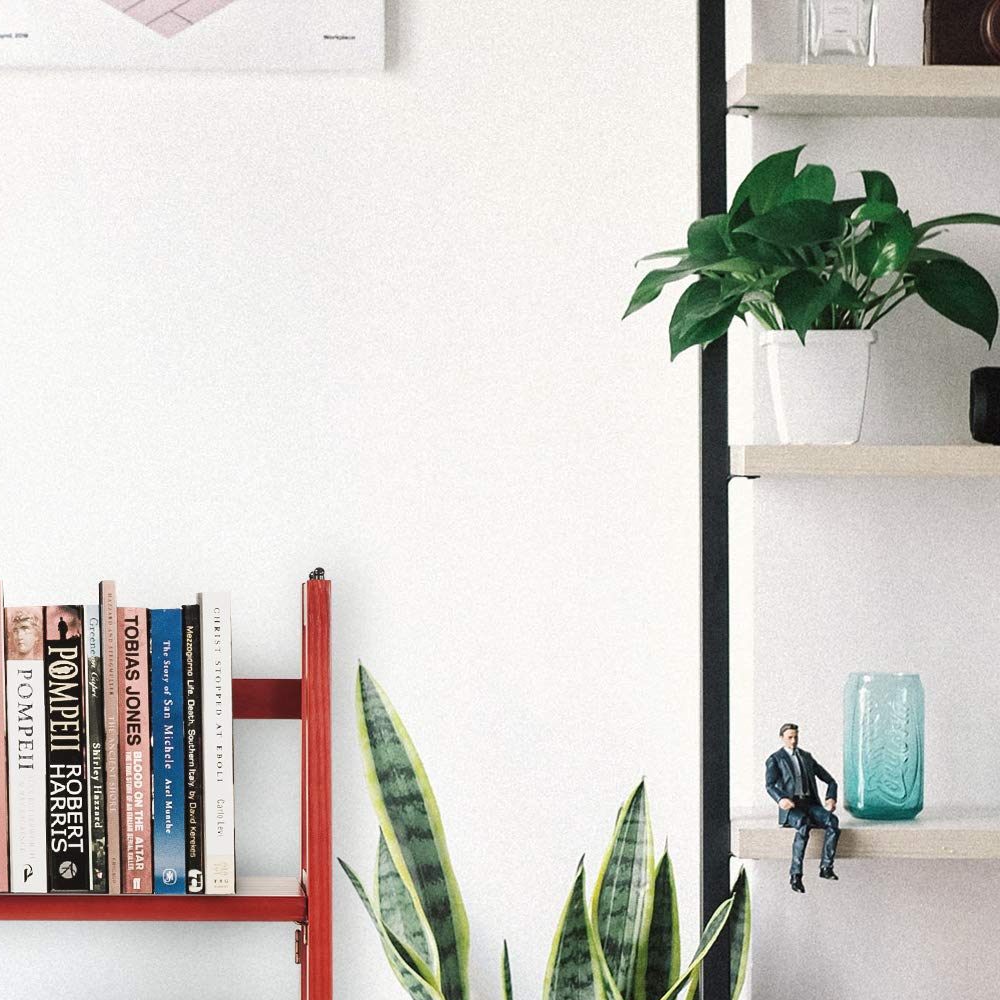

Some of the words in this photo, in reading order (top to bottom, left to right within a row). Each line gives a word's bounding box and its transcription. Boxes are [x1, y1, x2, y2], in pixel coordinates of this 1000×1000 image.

[88, 617, 98, 655] Greene
[124, 615, 140, 681] TOBIAS
[213, 607, 221, 652] CHRIST
[163, 640, 171, 657] The
[185, 625, 194, 677] Mezzogiorno
[162, 660, 172, 683] Story
[214, 661, 222, 716] STOPPED
[48, 645, 80, 751] POMPEII
[163, 686, 171, 695] of
[163, 699, 173, 719] San
[17, 669, 34, 769] POMPEII
[126, 686, 142, 746] JONES
[216, 724, 223, 737] AT
[91, 742, 102, 781] Shirley
[164, 724, 175, 770] Michele
[188, 729, 196, 767] Southern
[133, 751, 143, 788] BLOOD
[165, 778, 173, 797] Axel
[50, 764, 67, 853] HARRIS
[65, 764, 84, 853] ROBERT
[93, 785, 103, 829] Hazzard
[133, 791, 143, 807] ON
[188, 791, 196, 801] by
[189, 802, 197, 827] David
[134, 809, 144, 831] THE
[165, 801, 174, 834] Munthe
[134, 837, 145, 870] ALTAR
[189, 827, 197, 858] Kerekes
